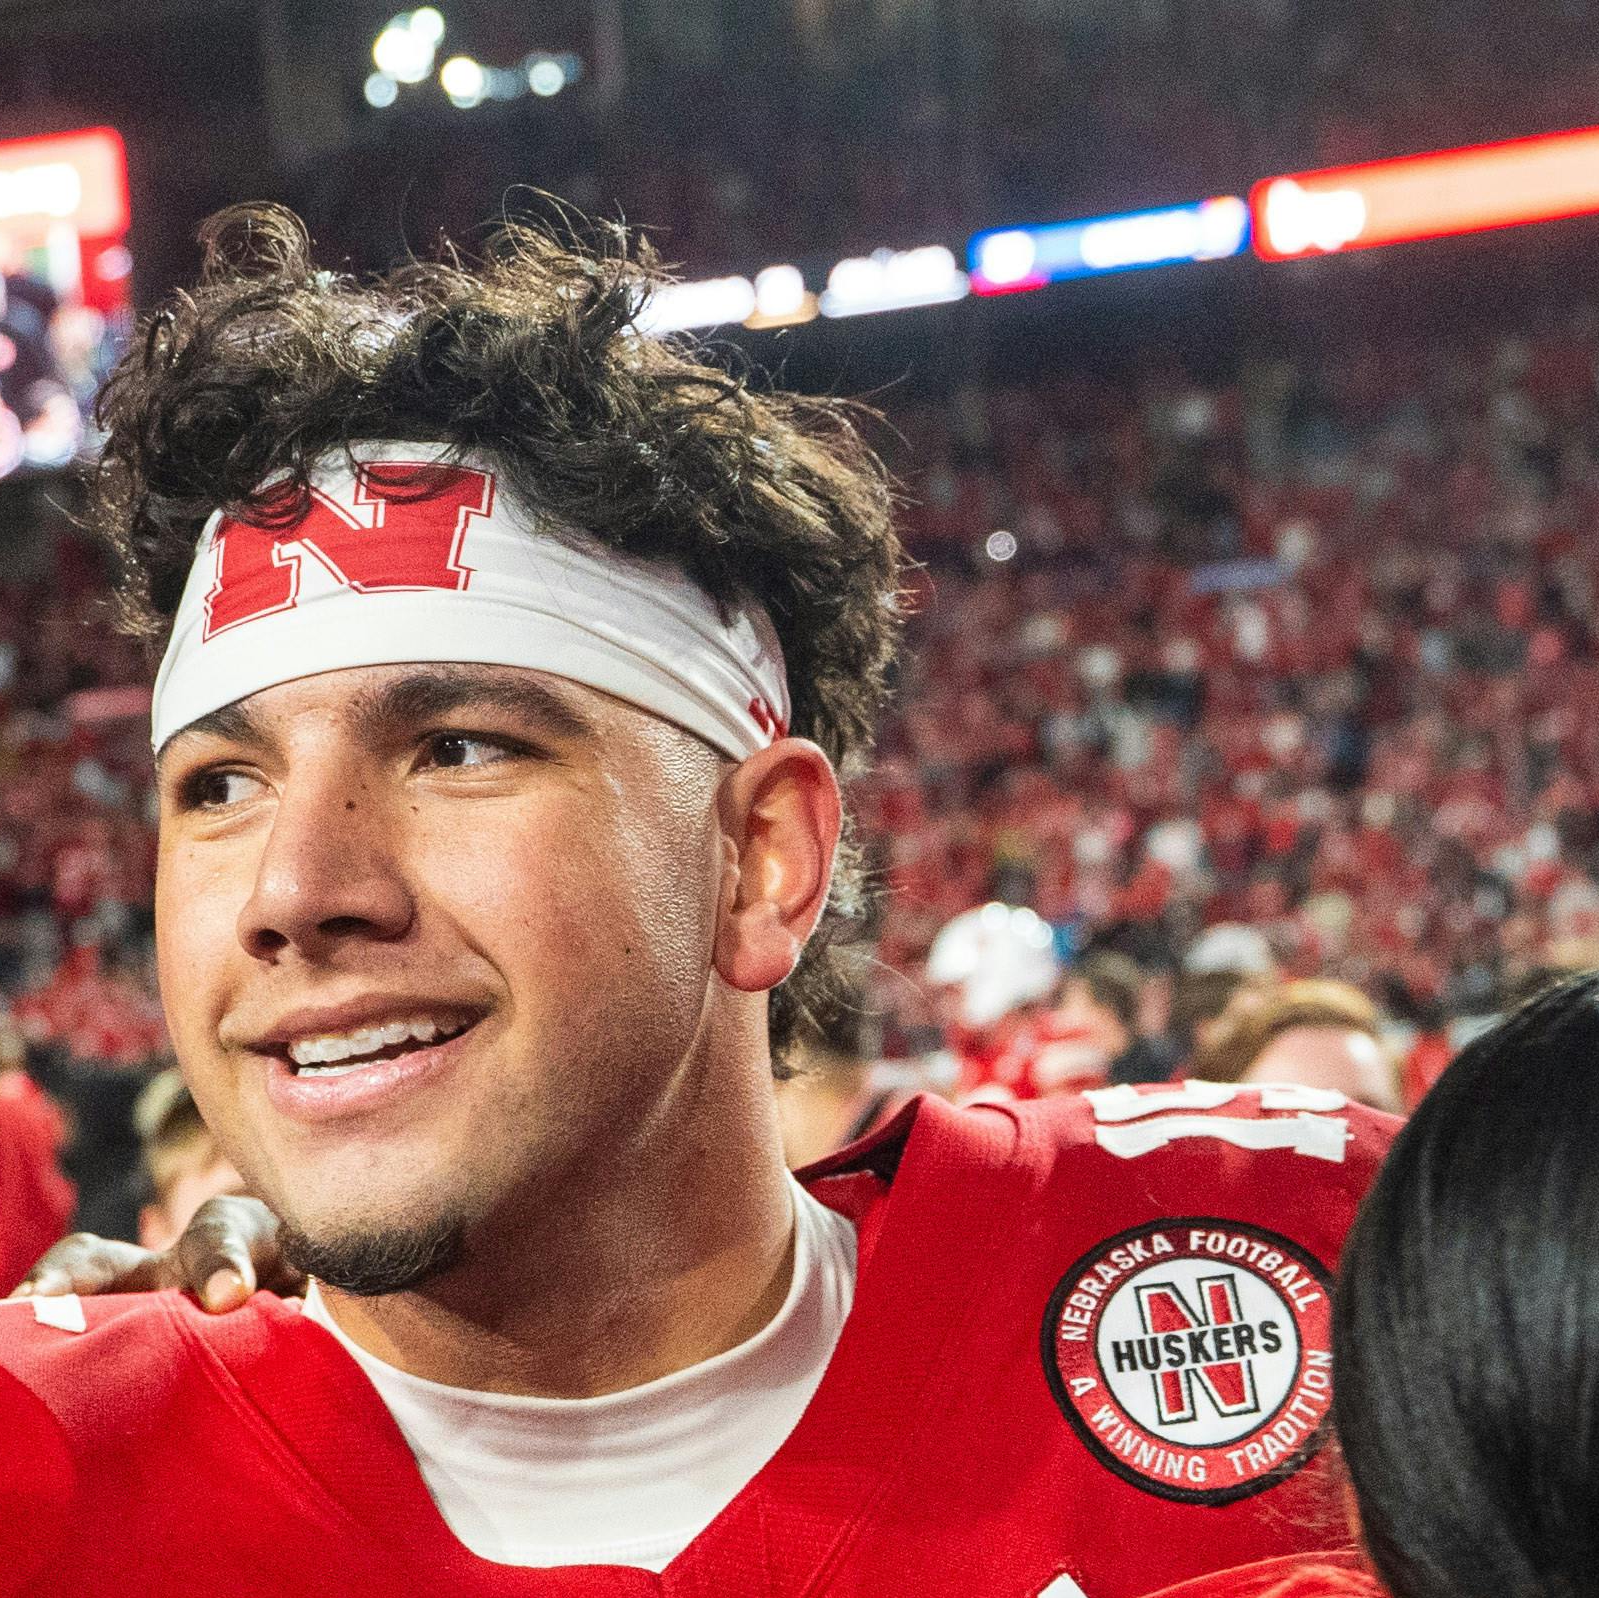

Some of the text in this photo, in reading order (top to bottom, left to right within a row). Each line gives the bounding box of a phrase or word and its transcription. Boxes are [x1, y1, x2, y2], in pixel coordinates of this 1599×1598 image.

[203, 461, 495, 644] N
[1061, 1230, 1322, 1342] NEBRASKA FOOTBALL
[1111, 1320, 1283, 1373] HUSKERS
[1070, 1350, 1334, 1483] A WINNING TRADITION
